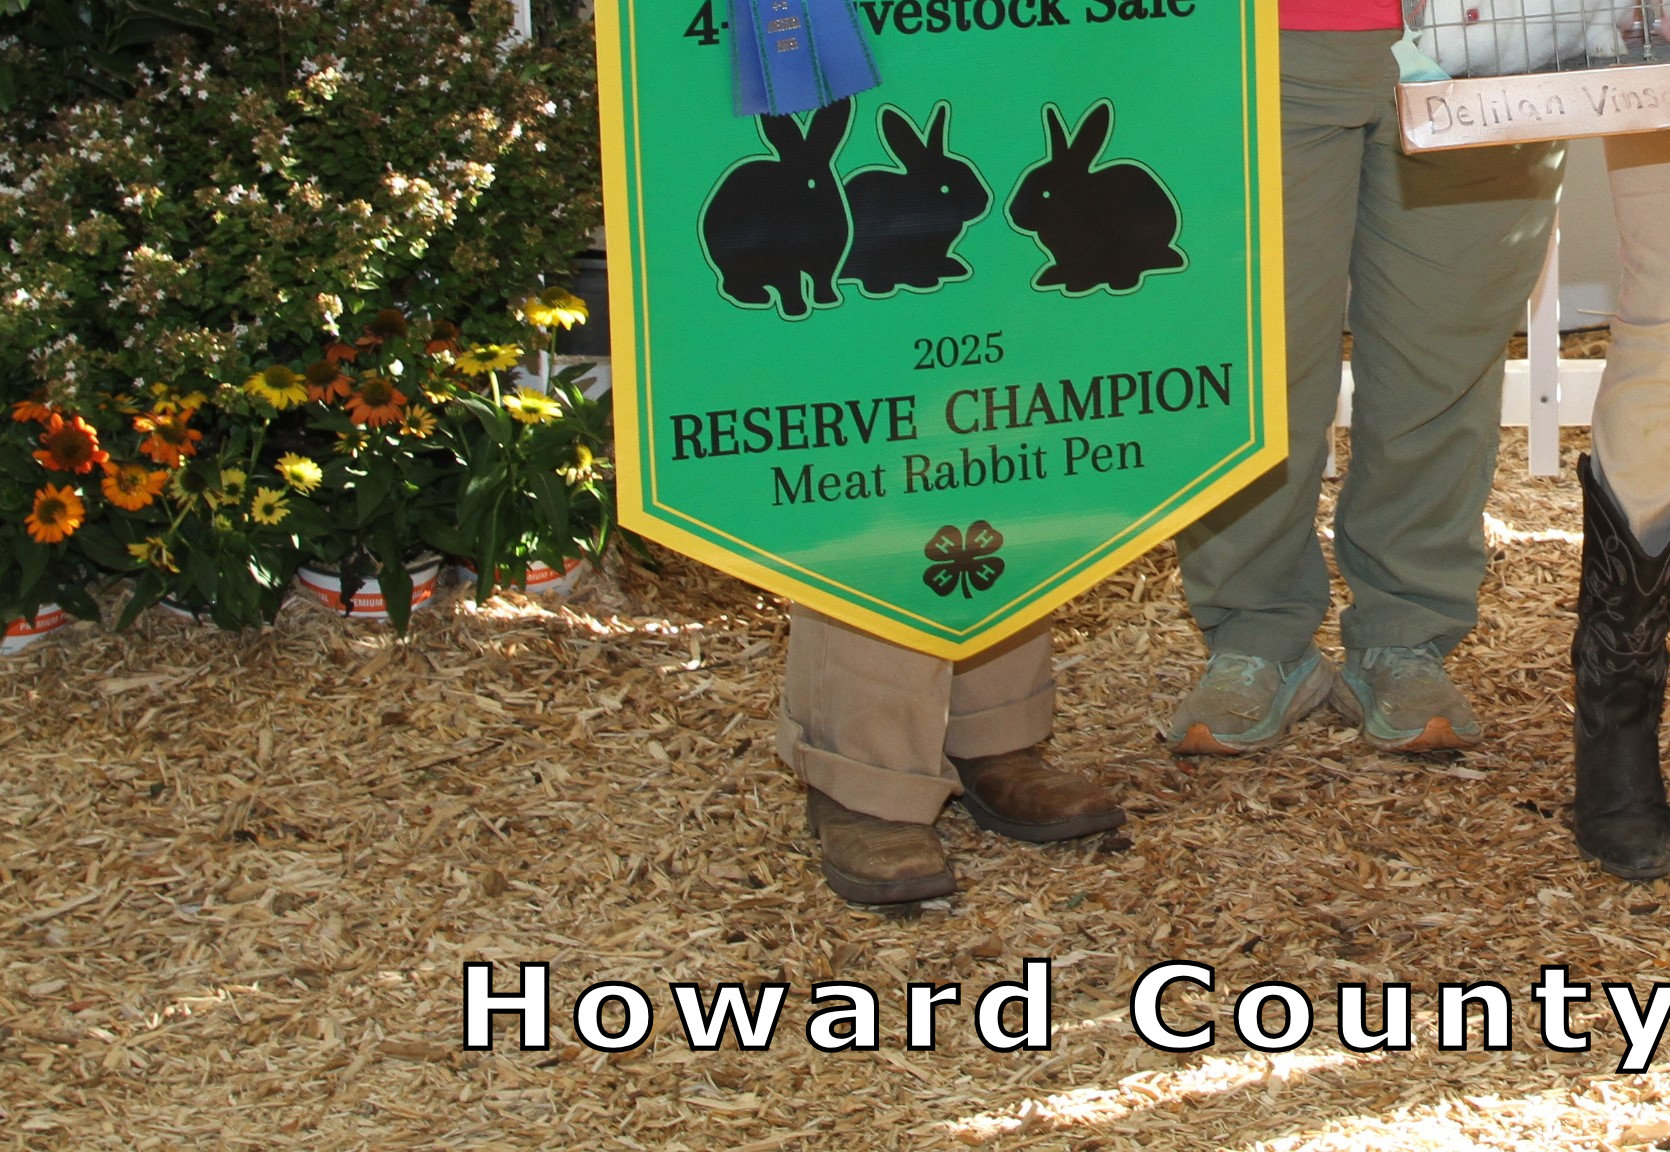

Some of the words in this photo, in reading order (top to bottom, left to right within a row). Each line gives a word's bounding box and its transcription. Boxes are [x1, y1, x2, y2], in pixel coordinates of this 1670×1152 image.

[683, 0, 729, 46] 4-
[913, 330, 1004, 370] 2025
[669, 394, 918, 461] RESERVE
[944, 362, 1233, 435] CHAMPION
[771, 464, 887, 507] Meat
[902, 442, 1047, 494] Rabbit
[1062, 436, 1145, 476] Pen
